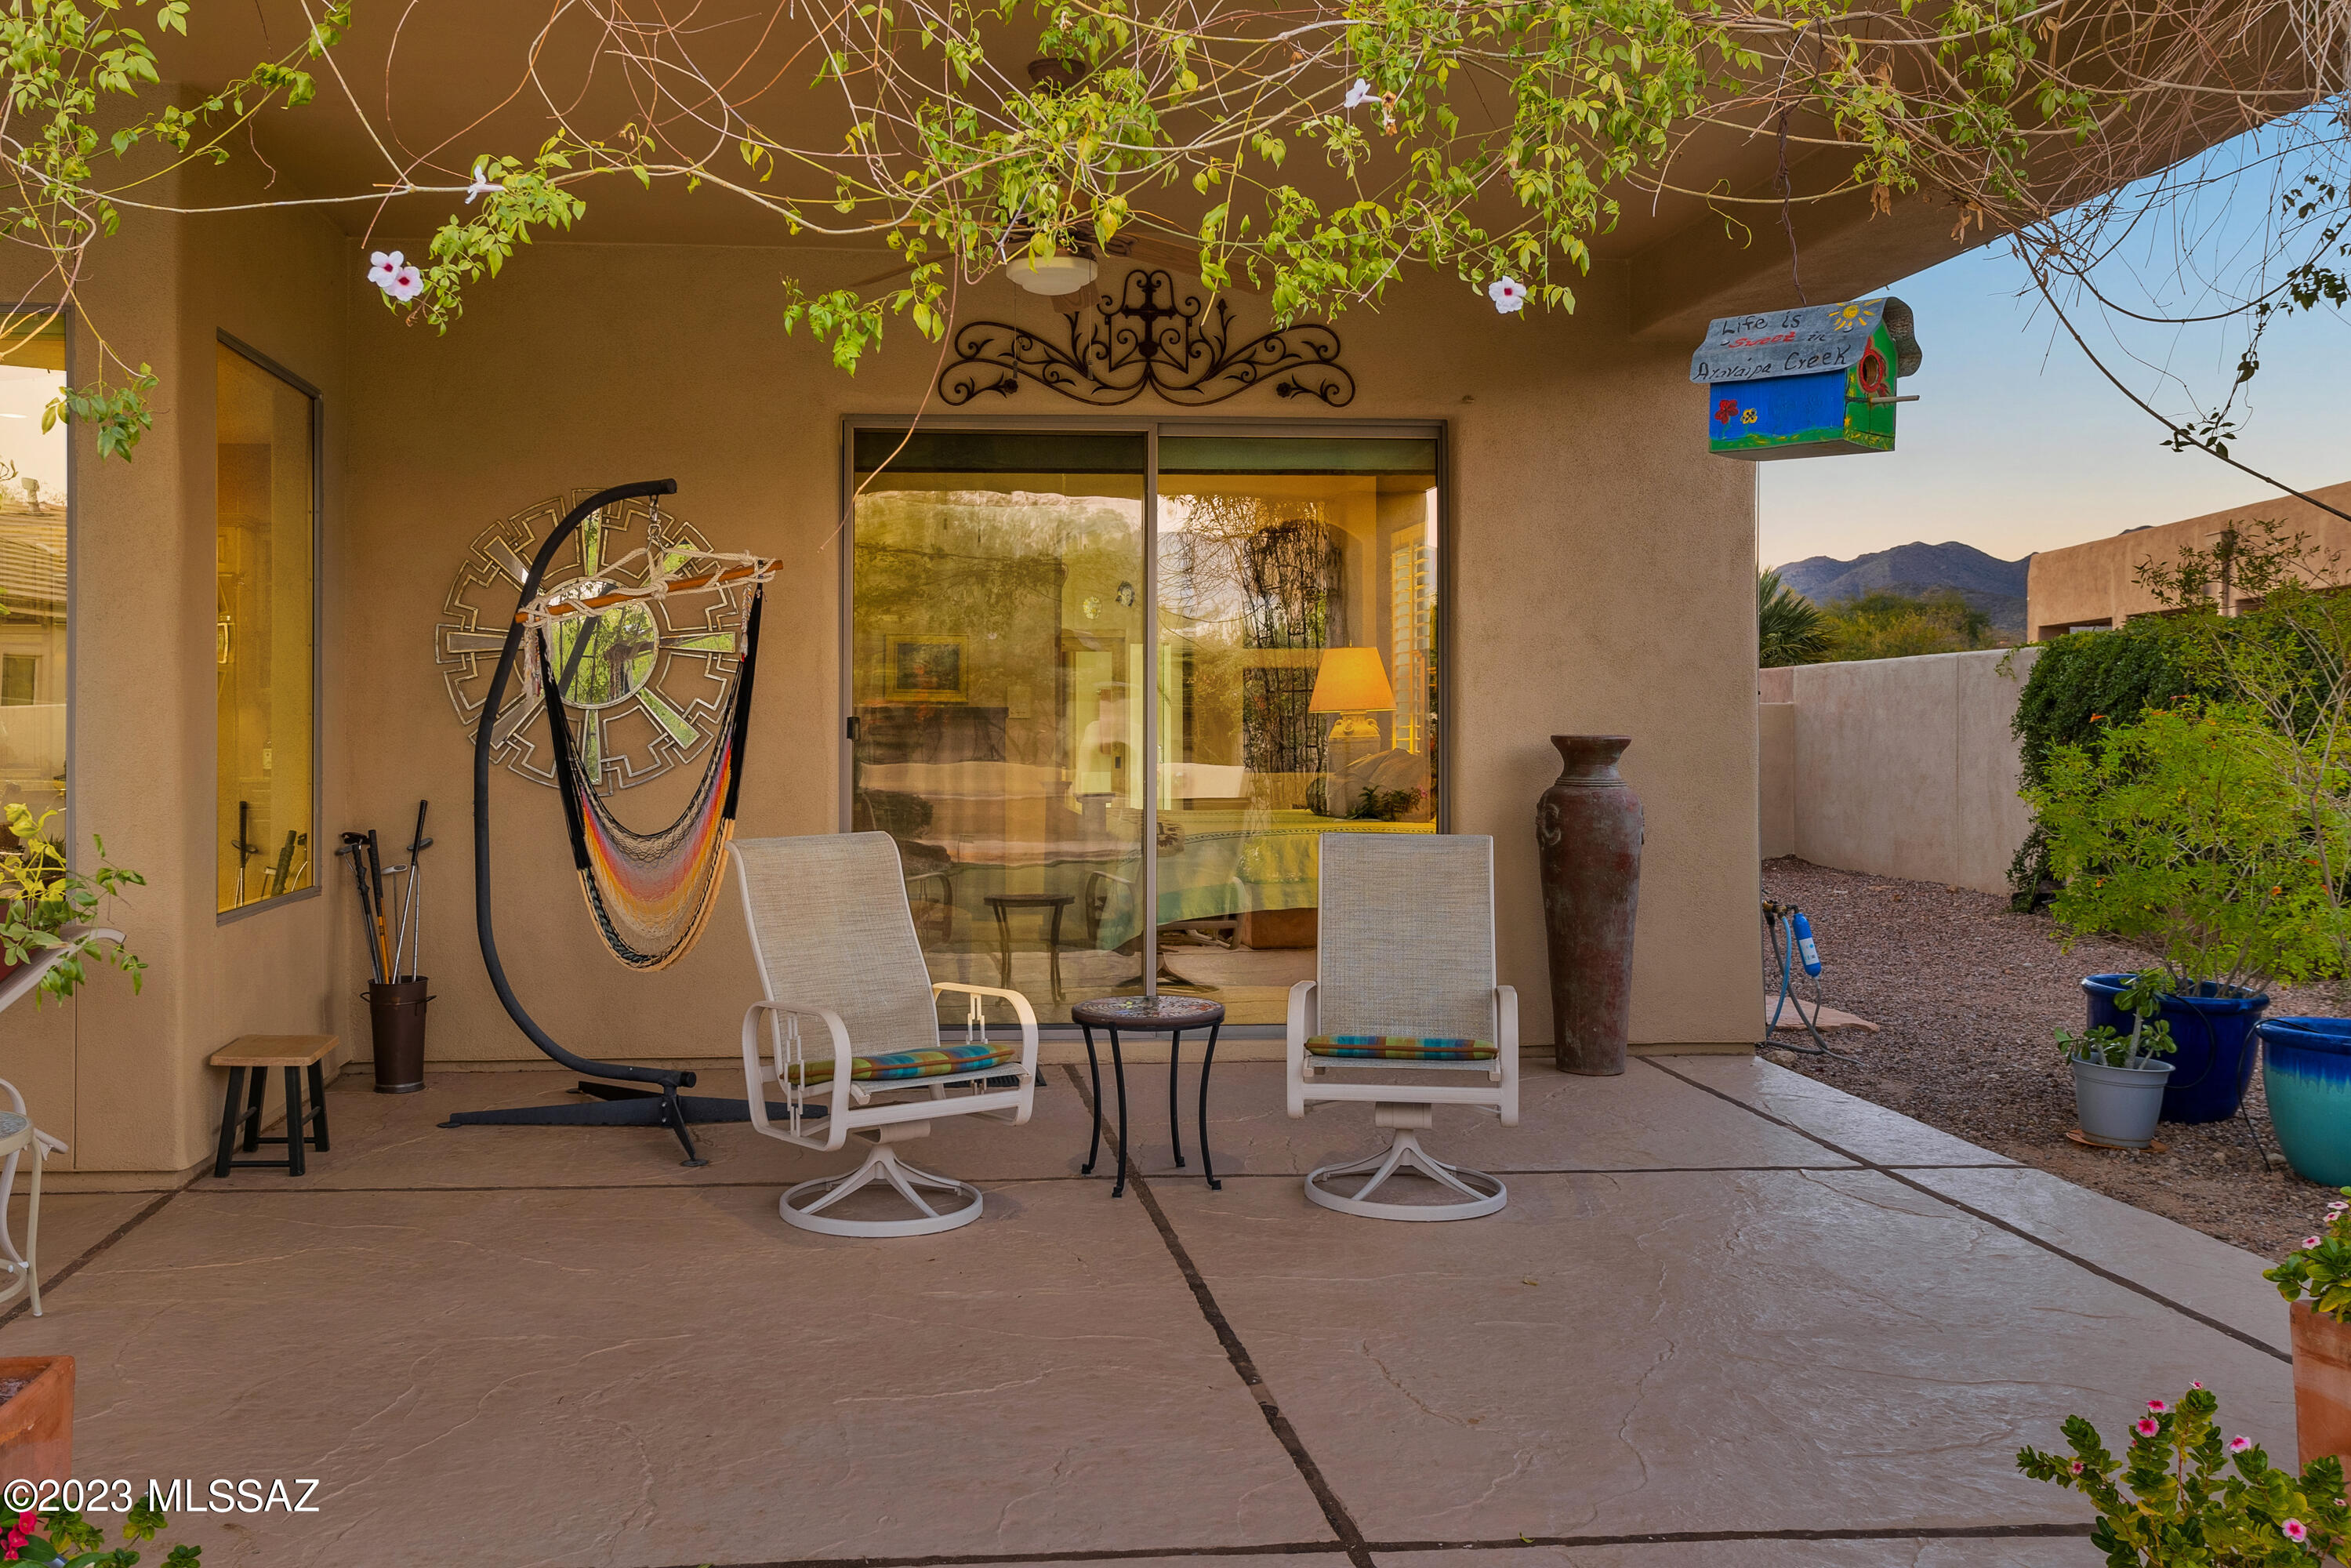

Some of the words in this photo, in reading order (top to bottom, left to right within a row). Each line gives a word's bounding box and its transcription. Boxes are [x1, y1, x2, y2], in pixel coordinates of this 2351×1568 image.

[1722, 315, 1769, 335] Life
[1781, 311, 1801, 328] is
[1808, 331, 1826, 342] in
